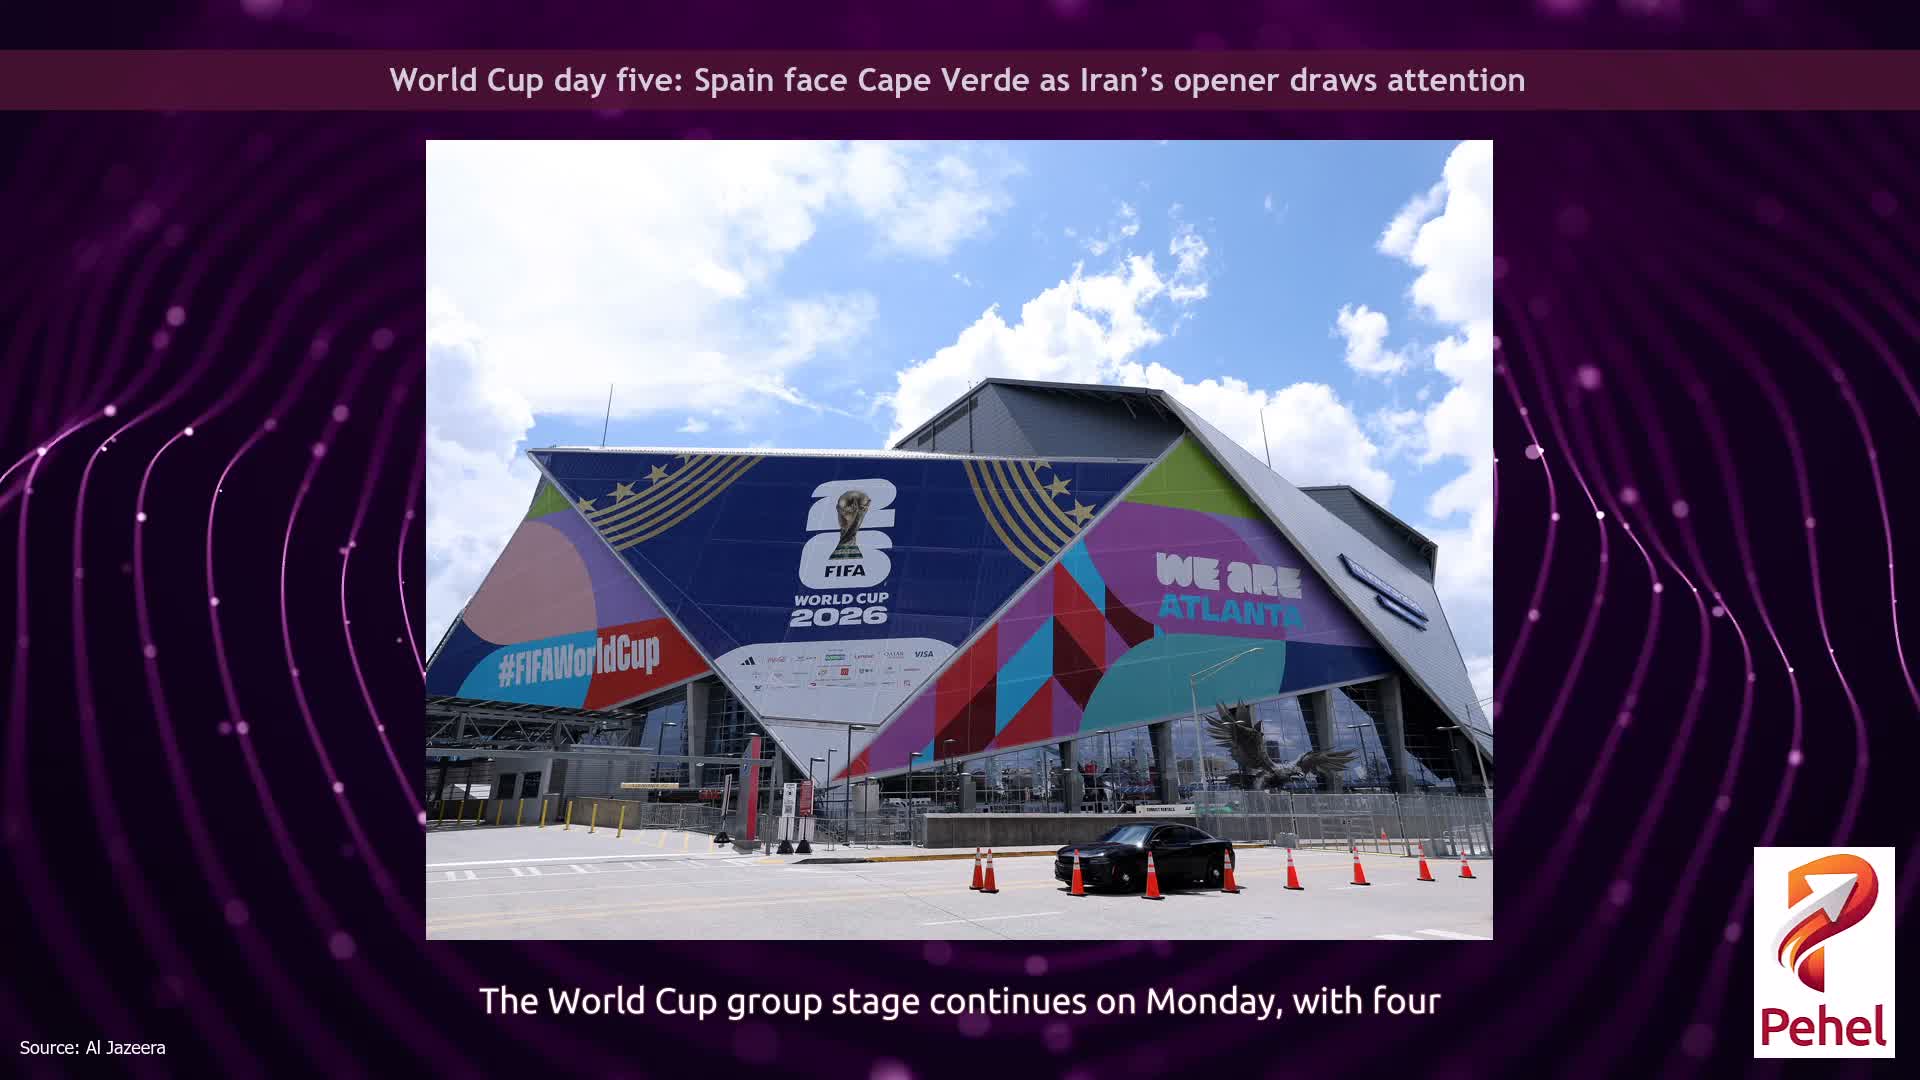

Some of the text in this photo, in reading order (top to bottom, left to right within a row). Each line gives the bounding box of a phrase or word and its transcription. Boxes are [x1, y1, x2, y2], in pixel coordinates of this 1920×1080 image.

[824, 564, 866, 578] FIFA
[1156, 551, 1220, 591] WE
[794, 592, 889, 607] WORLD CUP
[789, 606, 888, 628] 2026
[1157, 593, 1305, 629] ATLANTA
[498, 634, 660, 688] #FIFAWorldCup
[915, 650, 934, 658] VISA
